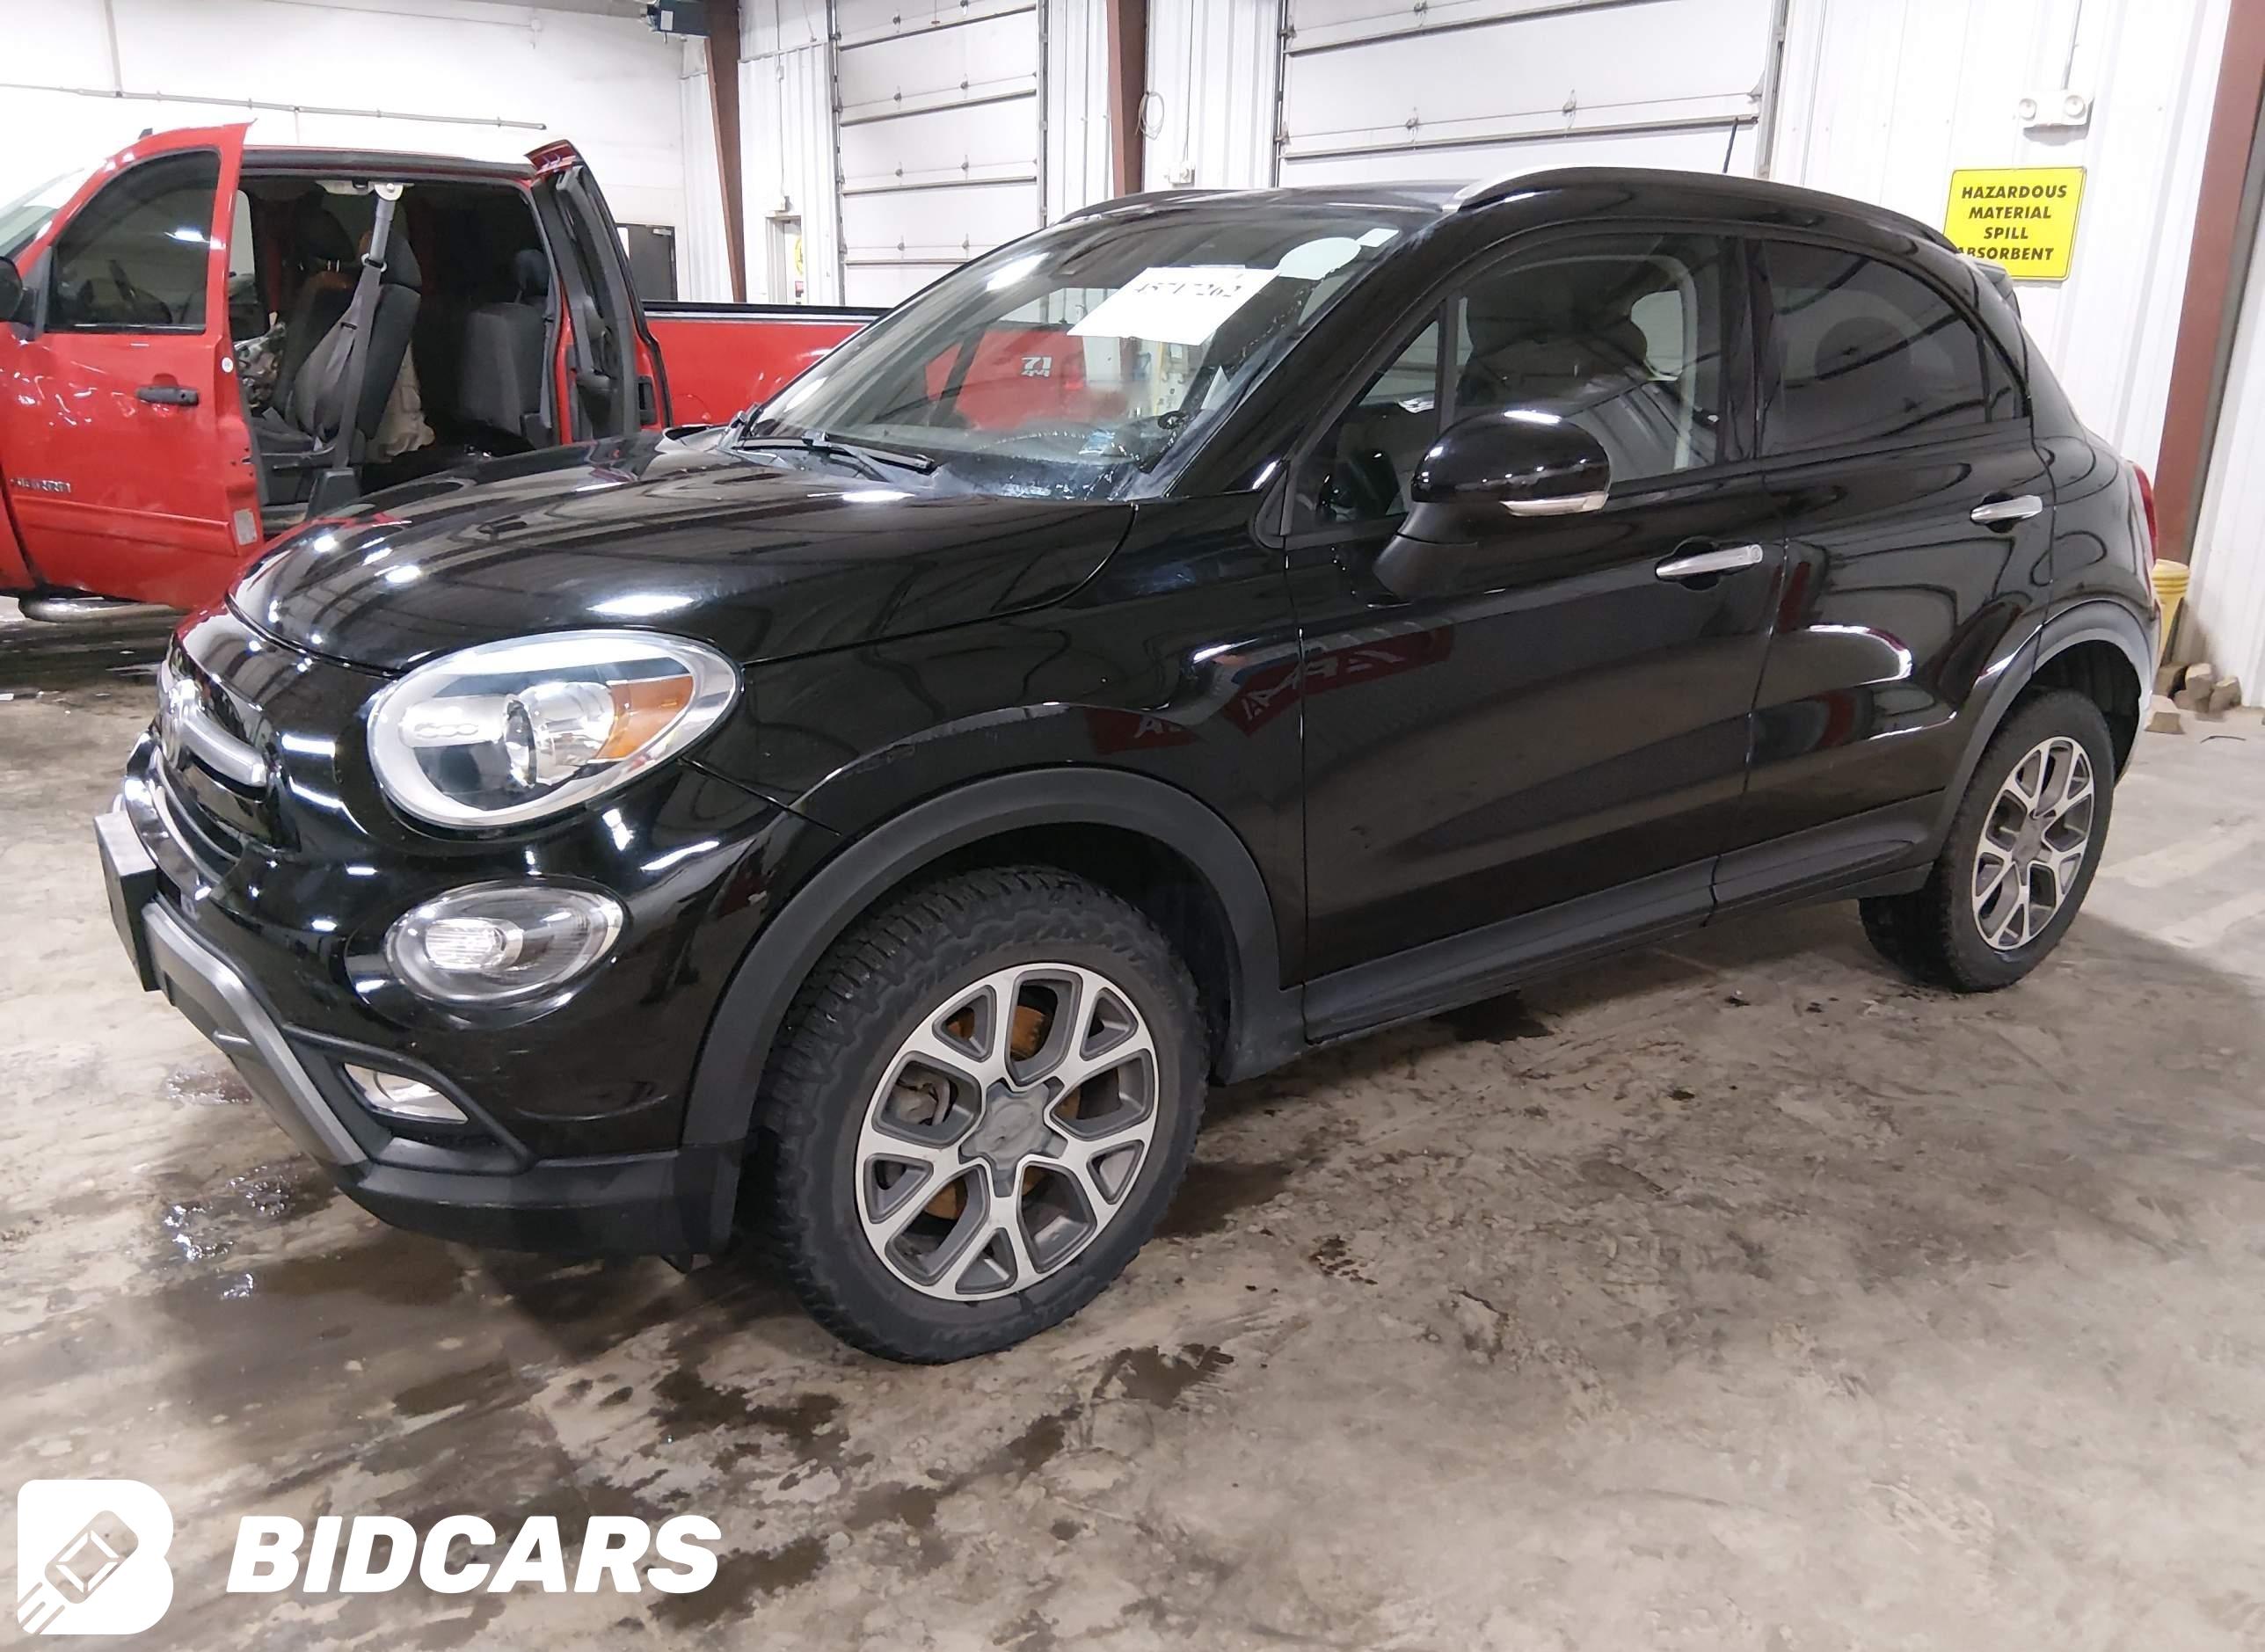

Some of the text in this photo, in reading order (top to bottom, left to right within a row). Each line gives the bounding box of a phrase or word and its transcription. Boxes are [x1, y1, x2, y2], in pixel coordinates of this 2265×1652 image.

[1962, 185, 2067, 199] HAZARDOUS
[1968, 206, 2051, 219] MATERIAL
[1984, 227, 2029, 239] SPILL
